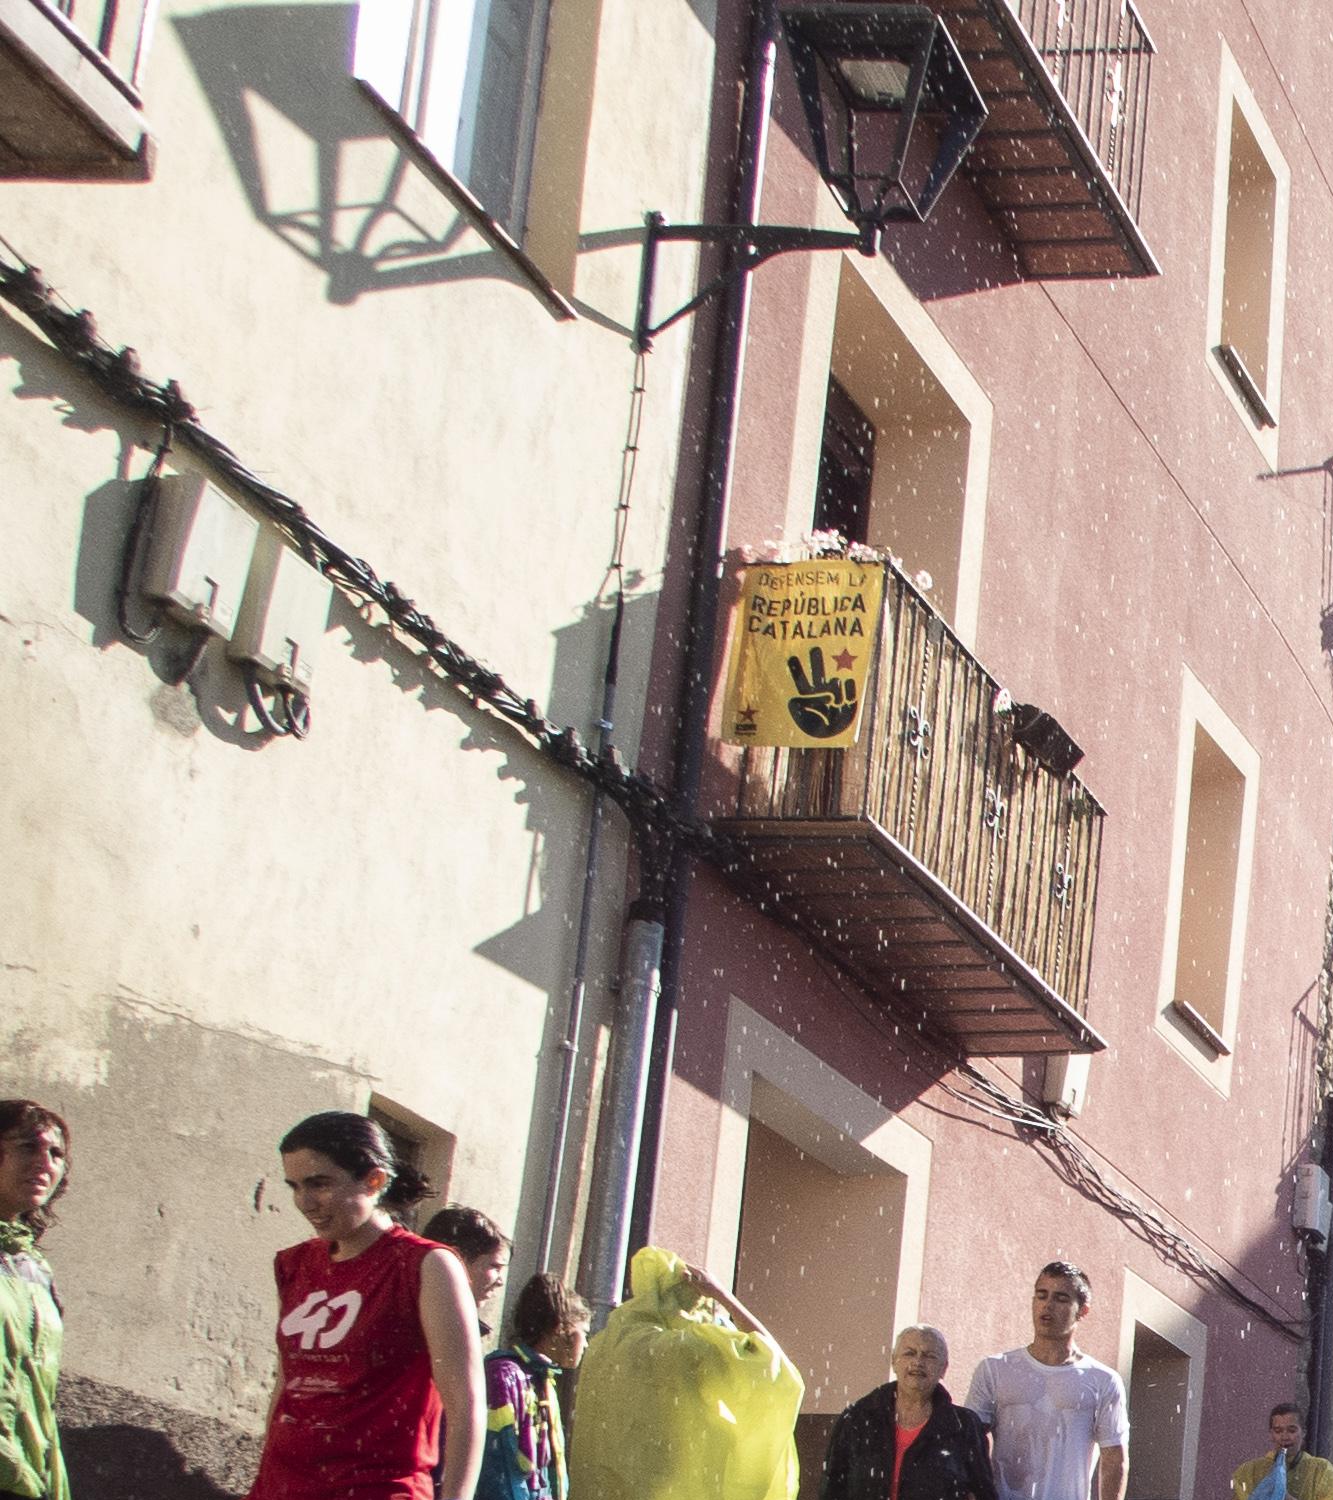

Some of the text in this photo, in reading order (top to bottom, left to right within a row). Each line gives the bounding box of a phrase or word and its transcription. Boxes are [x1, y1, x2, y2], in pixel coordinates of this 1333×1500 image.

[759, 571, 840, 590] DEFENSEM
[752, 591, 866, 617] REPÚBLICA
[748, 615, 864, 640] CATALANA
[281, 1290, 362, 1350] 40
